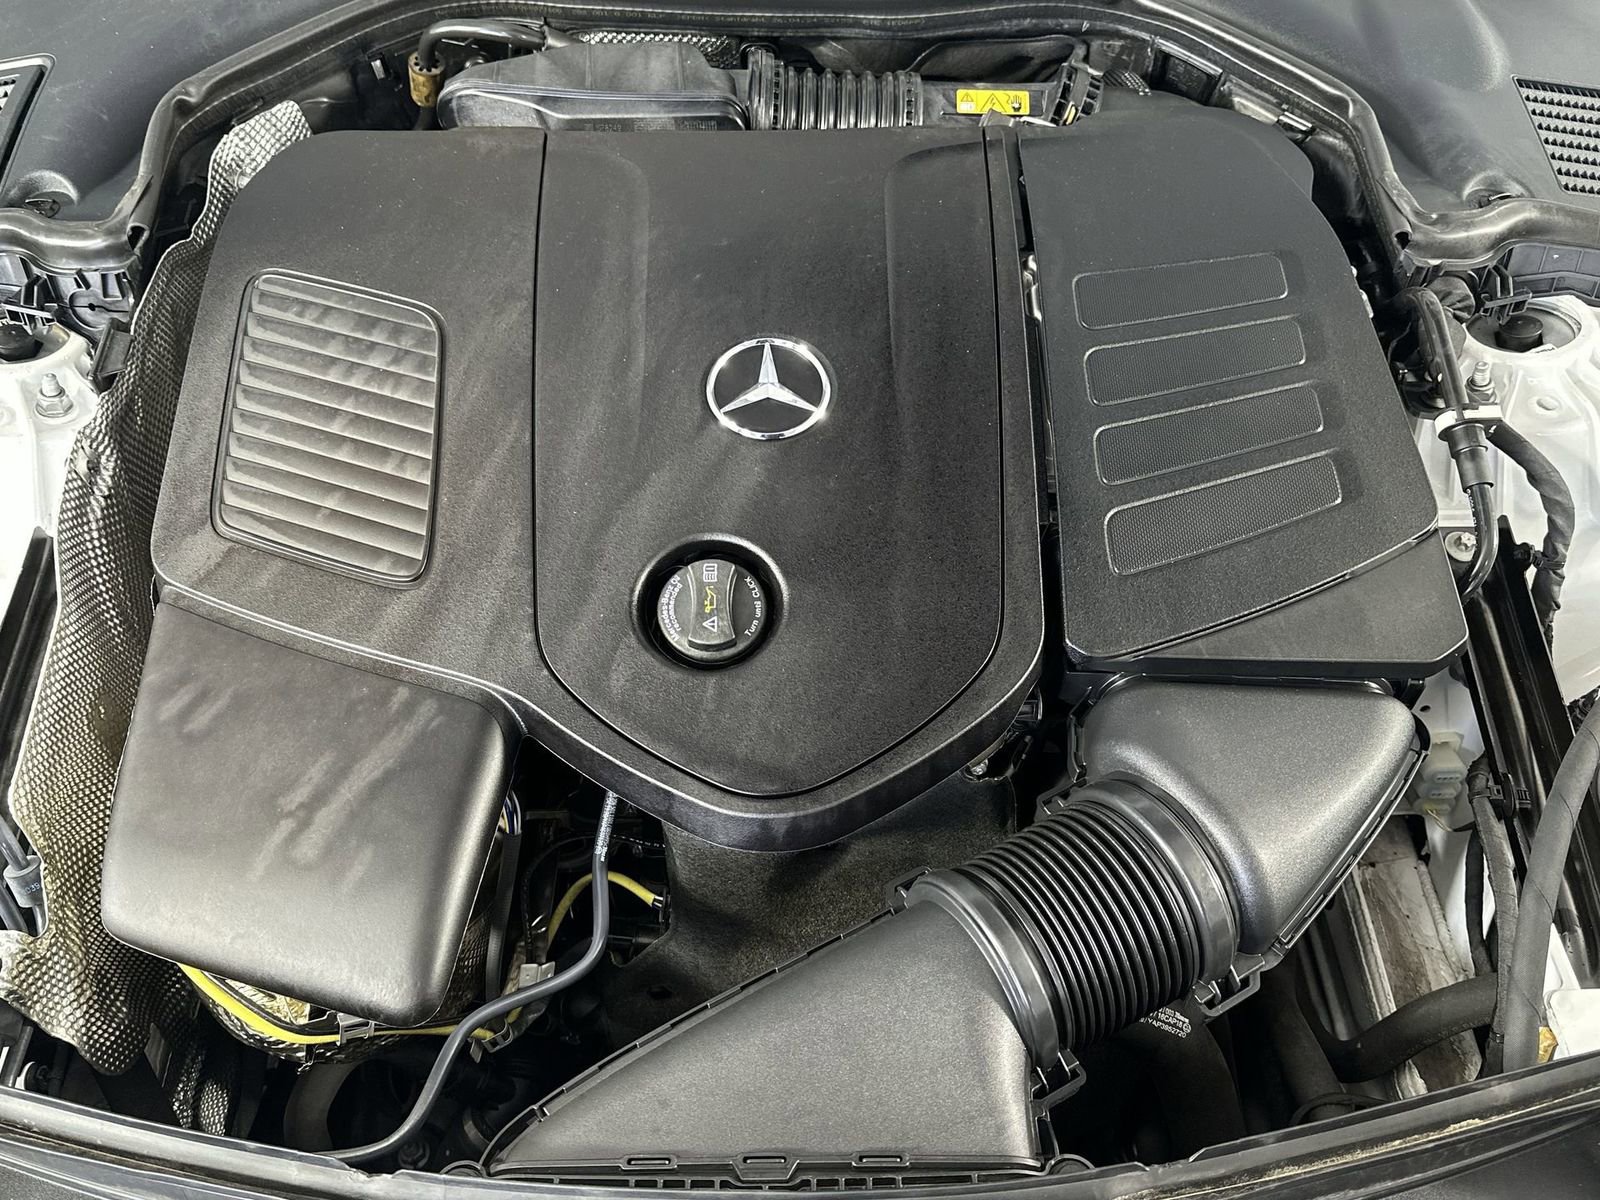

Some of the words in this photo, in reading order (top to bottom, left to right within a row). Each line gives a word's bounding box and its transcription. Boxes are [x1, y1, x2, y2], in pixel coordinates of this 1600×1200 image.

[744, 575, 760, 598] CLICK
[661, 585, 680, 641] Mercedes-Benz
[668, 583, 683, 631] recommended
[754, 600, 762, 618] until
[744, 620, 759, 636] Turn
